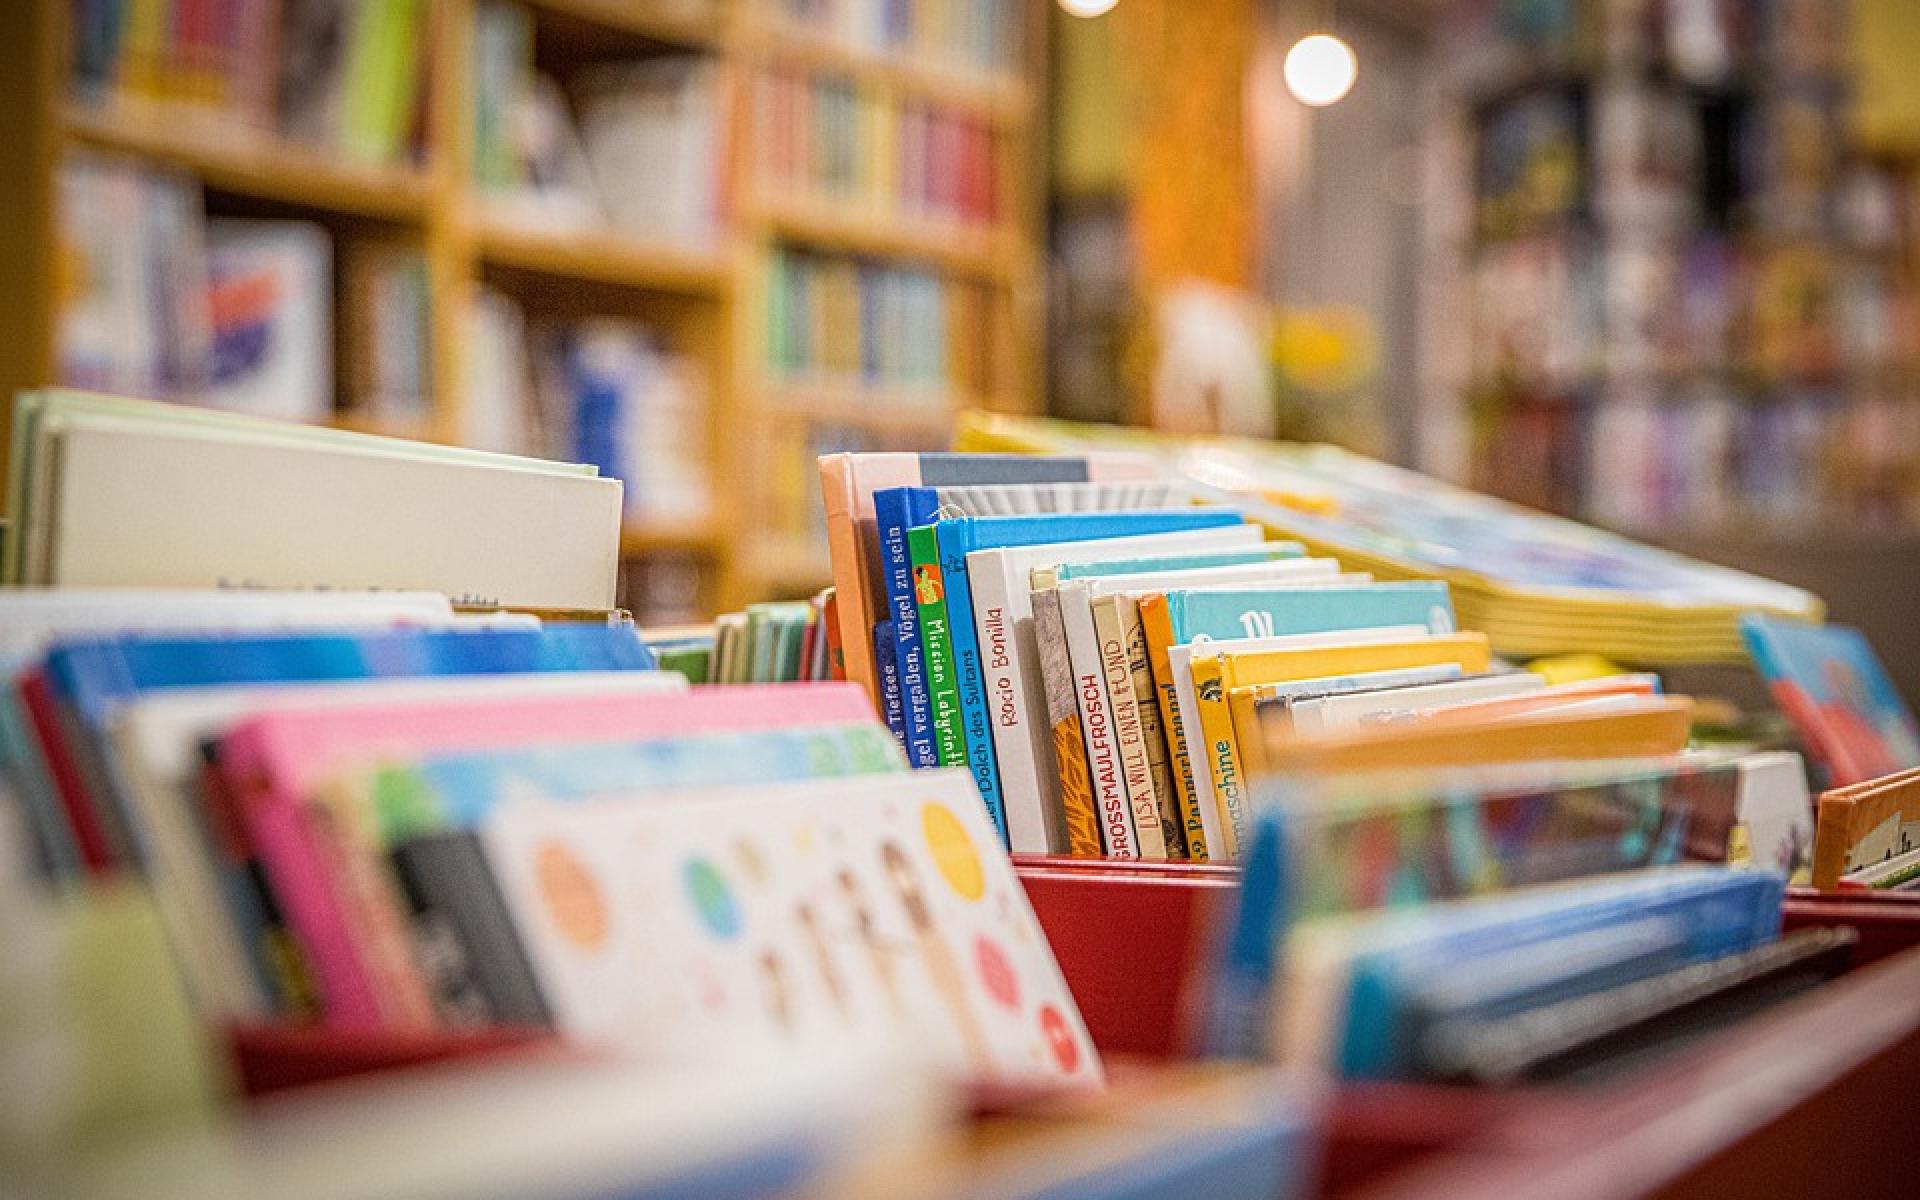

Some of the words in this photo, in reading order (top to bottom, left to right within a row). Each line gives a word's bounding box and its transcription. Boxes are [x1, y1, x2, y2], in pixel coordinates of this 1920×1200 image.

[886, 526, 905, 564] sein
[895, 567, 909, 589] zu
[894, 595, 917, 642] Vögel
[985, 607, 1009, 668] Bonilla
[927, 619, 946, 683] Mission
[1103, 639, 1131, 695] HUND
[884, 664, 902, 725] Tiefsee
[963, 649, 980, 706] Sultans
[969, 710, 985, 738] des
[995, 677, 1019, 727] Rocio
[1117, 699, 1140, 746] EINEN
[914, 739, 936, 768] gel
[974, 743, 993, 793] Dolch
[1126, 749, 1146, 788] WILL
